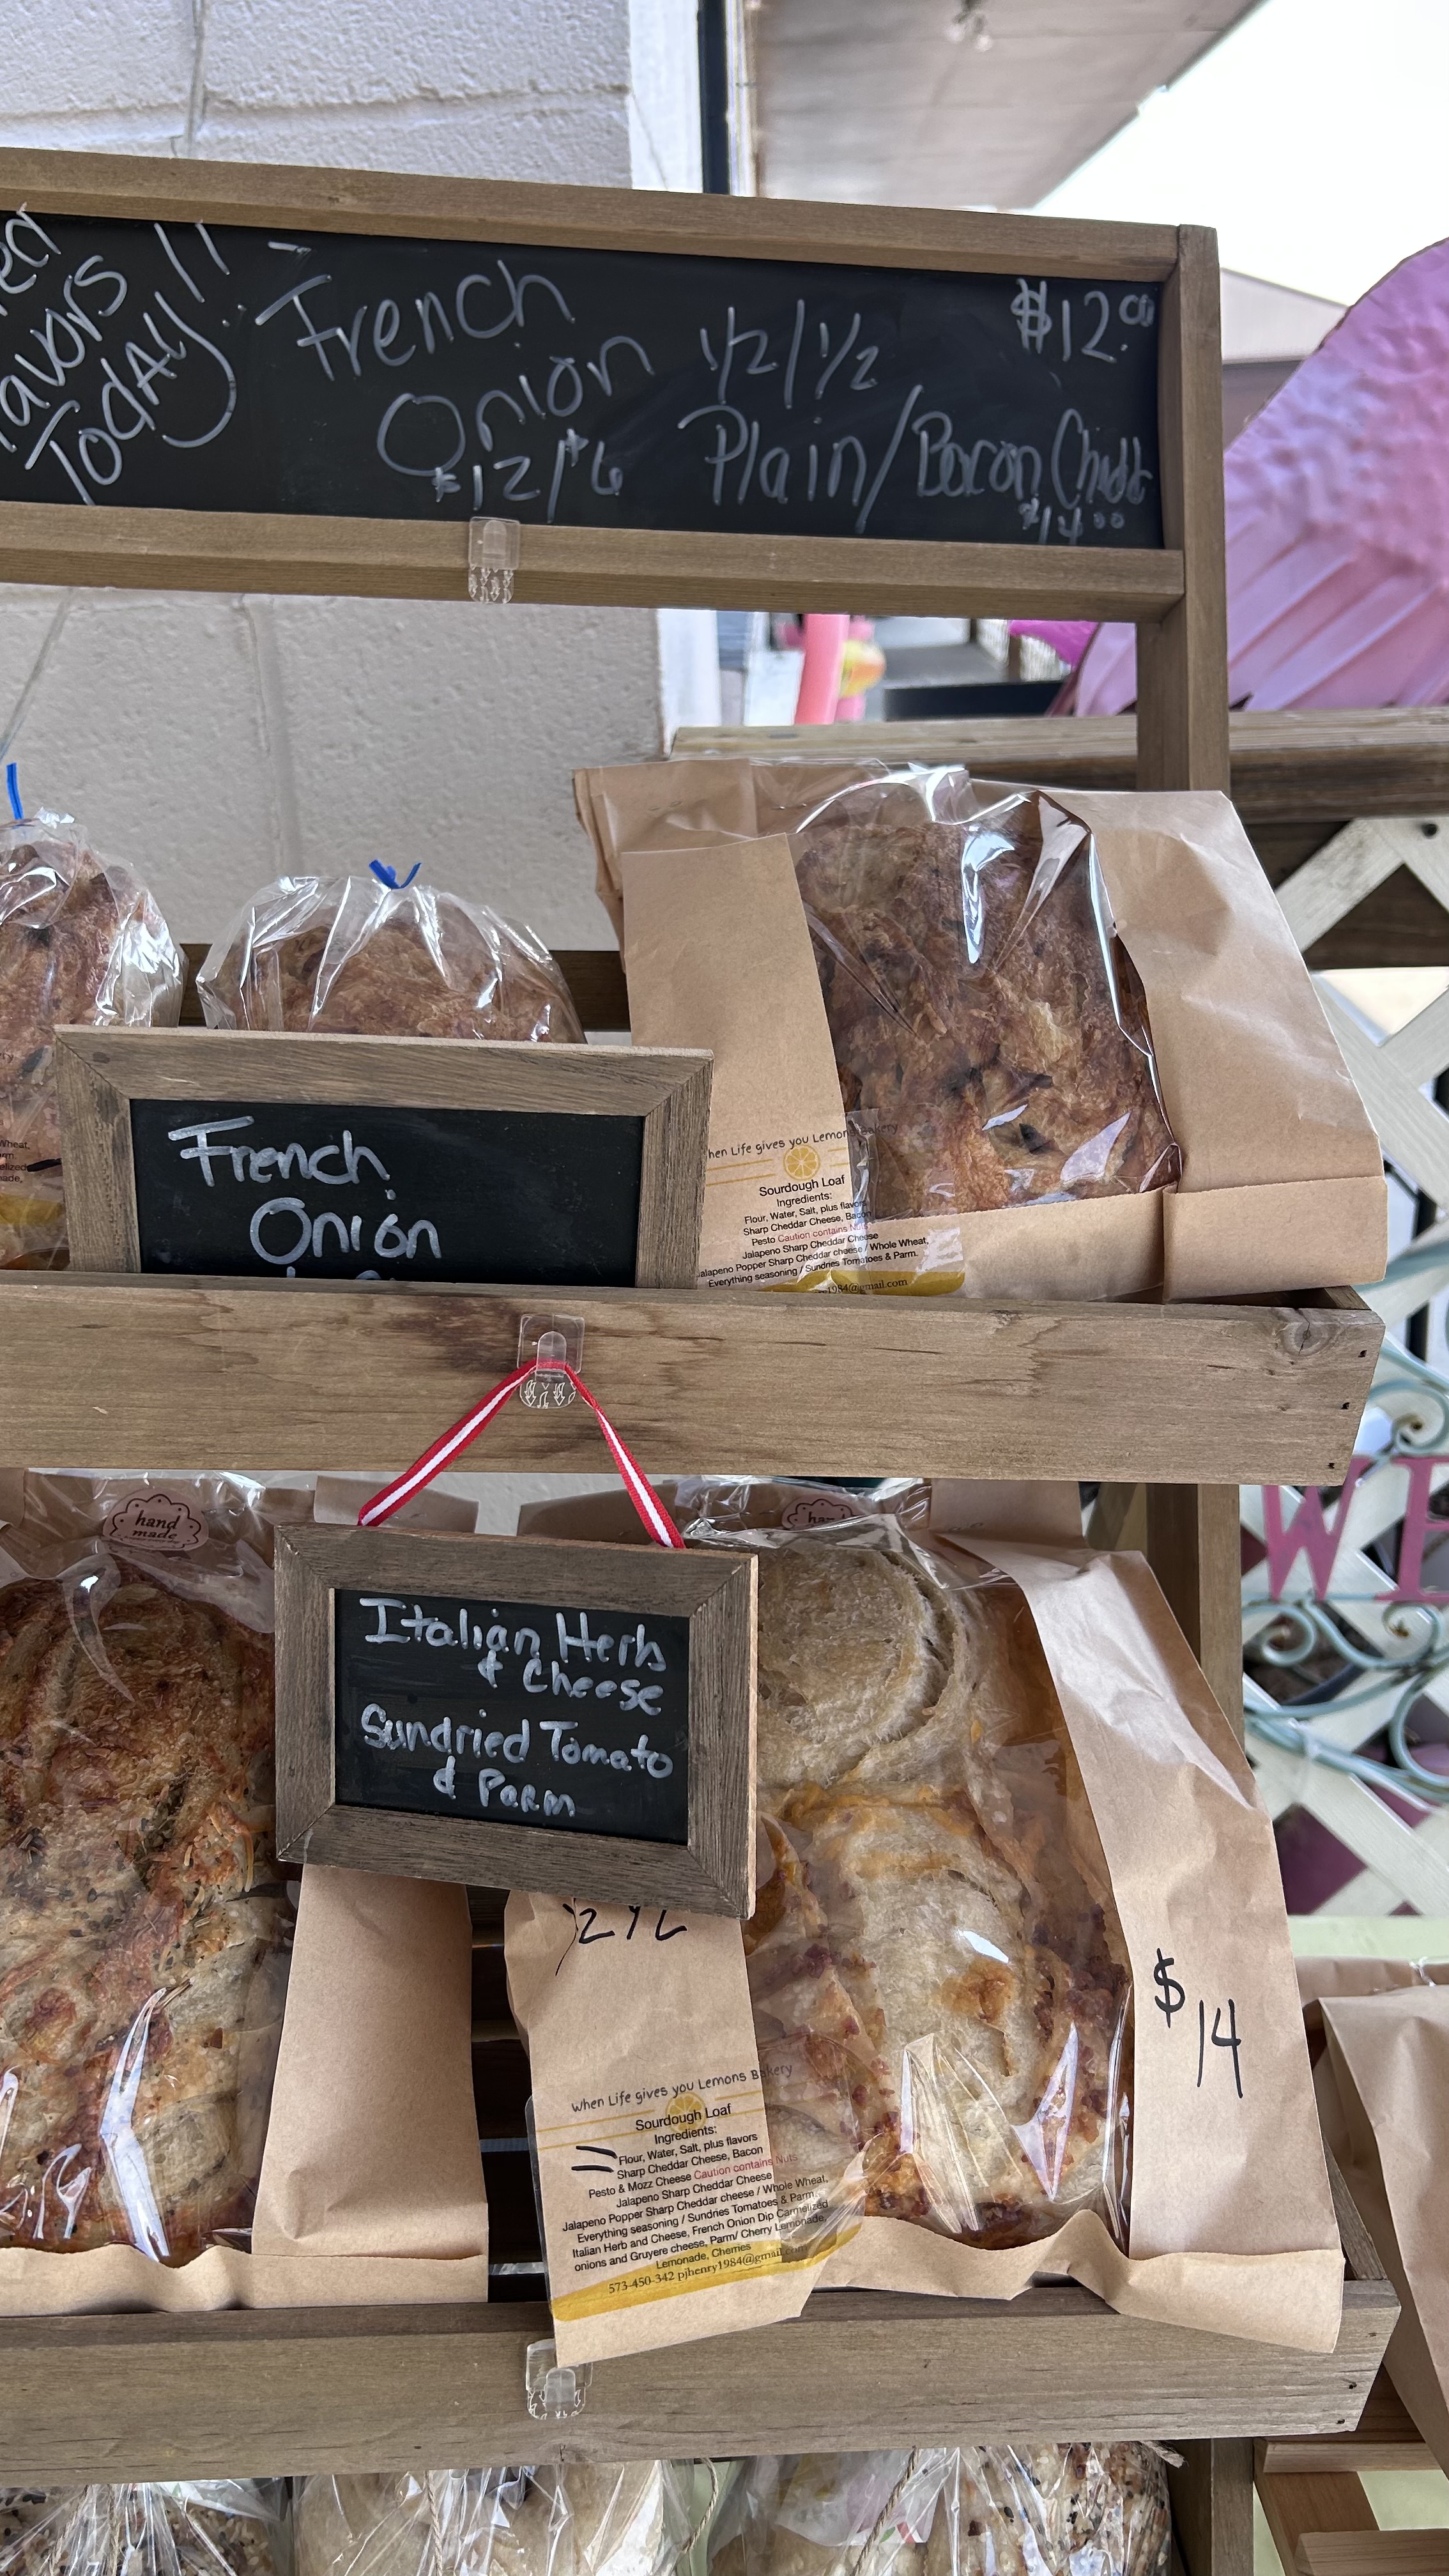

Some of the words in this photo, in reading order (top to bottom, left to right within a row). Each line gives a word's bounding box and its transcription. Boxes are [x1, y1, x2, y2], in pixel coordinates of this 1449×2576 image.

[257, 259, 575, 381] French
[0, 256, 128, 452] avors
[377, 335, 655, 477] Onion
[168, 1115, 391, 1187] French
[707, 1148, 727, 1158] hen
[731, 1142, 751, 1155] Life
[755, 1140, 785, 1154] gives
[788, 1136, 808, 1149] you
[812, 1127, 856, 1143] Lemons
[759, 1179, 818, 1196] Sourdough
[821, 1174, 844, 1186] Loaf
[776, 1192, 831, 1208] Ingredients:
[250, 1189, 442, 1265] Onion
[743, 1227, 768, 1236] Sharp
[770, 1220, 807, 1231] Cheddar
[809, 1216, 843, 1225] Cheese,
[845, 1209, 871, 1220] Bacon
[744, 1215, 768, 1224] Flour,
[769, 1211, 797, 1220] Water,
[799, 1206, 818, 1215] Salt,
[820, 1204, 838, 1214] plus
[839, 1197, 866, 1209] flavors
[735, 1261, 766, 1271] Popper
[768, 1257, 793, 1266] Sharp
[795, 1250, 831, 1262] Cheddar
[870, 1239, 897, 1252] Whole
[898, 1234, 928, 1249] Wheat,
[742, 1248, 780, 1259] Jalapeno
[782, 1244, 808, 1252] Sharp
[809, 1237, 845, 1248] Cheddar
[847, 1230, 878, 1243] Cheese
[751, 1236, 775, 1246] Pesto
[778, 1232, 810, 1242] Caution
[812, 1226, 847, 1237] contains
[708, 1275, 752, 1287] Everything
[755, 1268, 797, 1280] seasoning
[804, 1259, 840, 1273] Sundries
[842, 1252, 883, 1267] Tomatoes
[893, 1251, 917, 1259] Parm.
[818, 1279, 908, 1294] 1984@gmail.com
[132, 1528, 178, 1540] made
[135, 1510, 181, 1529] hand
[360, 1597, 540, 1659] Italian
[556, 1611, 666, 1672] Herb
[523, 1658, 664, 1716] Cheese
[361, 1703, 530, 1763] Sundried
[539, 1720, 674, 1779] Tomato
[571, 2098, 604, 2112] When
[608, 2090, 631, 2106] Life
[635, 2087, 668, 2104] gives
[672, 2082, 693, 2098] you
[698, 2072, 746, 2089] Lemons
[751, 2062, 794, 2081] Bakery
[635, 2110, 702, 2132] Sourdough
[705, 2103, 730, 2118] Loaf
[618, 2152, 645, 2166] Flour,
[647, 2149, 677, 2159] Water,
[679, 2143, 701, 2154] Salt,
[703, 2140, 724, 2152] plus
[726, 2134, 757, 2145] flavors
[654, 2126, 717, 2145] Ingredients:
[588, 2187, 615, 2198] Pesto
[618, 2184, 625, 2193] &
[627, 2181, 653, 2191] Mozz
[656, 2174, 691, 2186] Cheese
[694, 2166, 730, 2179] Caution
[732, 2157, 773, 2172] contains
[775, 2152, 798, 2164] Nuts
[617, 2168, 645, 2179] Sharp
[647, 2159, 688, 2174] Cheddar
[691, 2153, 730, 2165] Cheese,
[732, 2146, 763, 2158] Bacon
[562, 2218, 606, 2231] Jalapeno
[608, 2211, 643, 2223] Popper
[645, 2205, 674, 2216] Sharp
[677, 2196, 717, 2210] Cheddar
[720, 2189, 754, 2202] cheese
[756, 2186, 761, 2195] /
[762, 2179, 793, 2194] Whole
[795, 2173, 828, 2189] Wheat,
[616, 2193, 659, 2207] Jalapeno
[661, 2188, 690, 2199] Sharp
[692, 2179, 733, 2193] Cheddar
[735, 2172, 772, 2184] Cheese
[572, 2246, 601, 2258] Italian
[604, 2241, 627, 2252] Herb
[630, 2236, 648, 2248] and
[651, 2230, 689, 2243] Cheese,
[692, 2221, 724, 2235] French
[726, 2216, 755, 2228] Onion
[757, 2212, 774, 2221] Dip
[577, 2228, 627, 2242] Everything
[630, 2218, 678, 2234] seasoning
[680, 2214, 686, 2224] /
[687, 2208, 729, 2222] Sundries
[731, 2196, 778, 2214] Tomatoes
[780, 2195, 788, 2204] &
[574, 2259, 606, 2271] onions
[609, 2253, 627, 2265] and
[630, 2248, 668, 2260] Gruyere
[670, 2239, 708, 2253] cheese,
[709, 2231, 738, 2244] Parm/
[740, 2226, 772, 2238] Cherry
[774, 2213, 827, 2232] Lemonade,
[656, 2252, 709, 2269] Lemonade,
[711, 2241, 751, 2258] Cherries
[608, 2271, 675, 2294] 573-450-342
